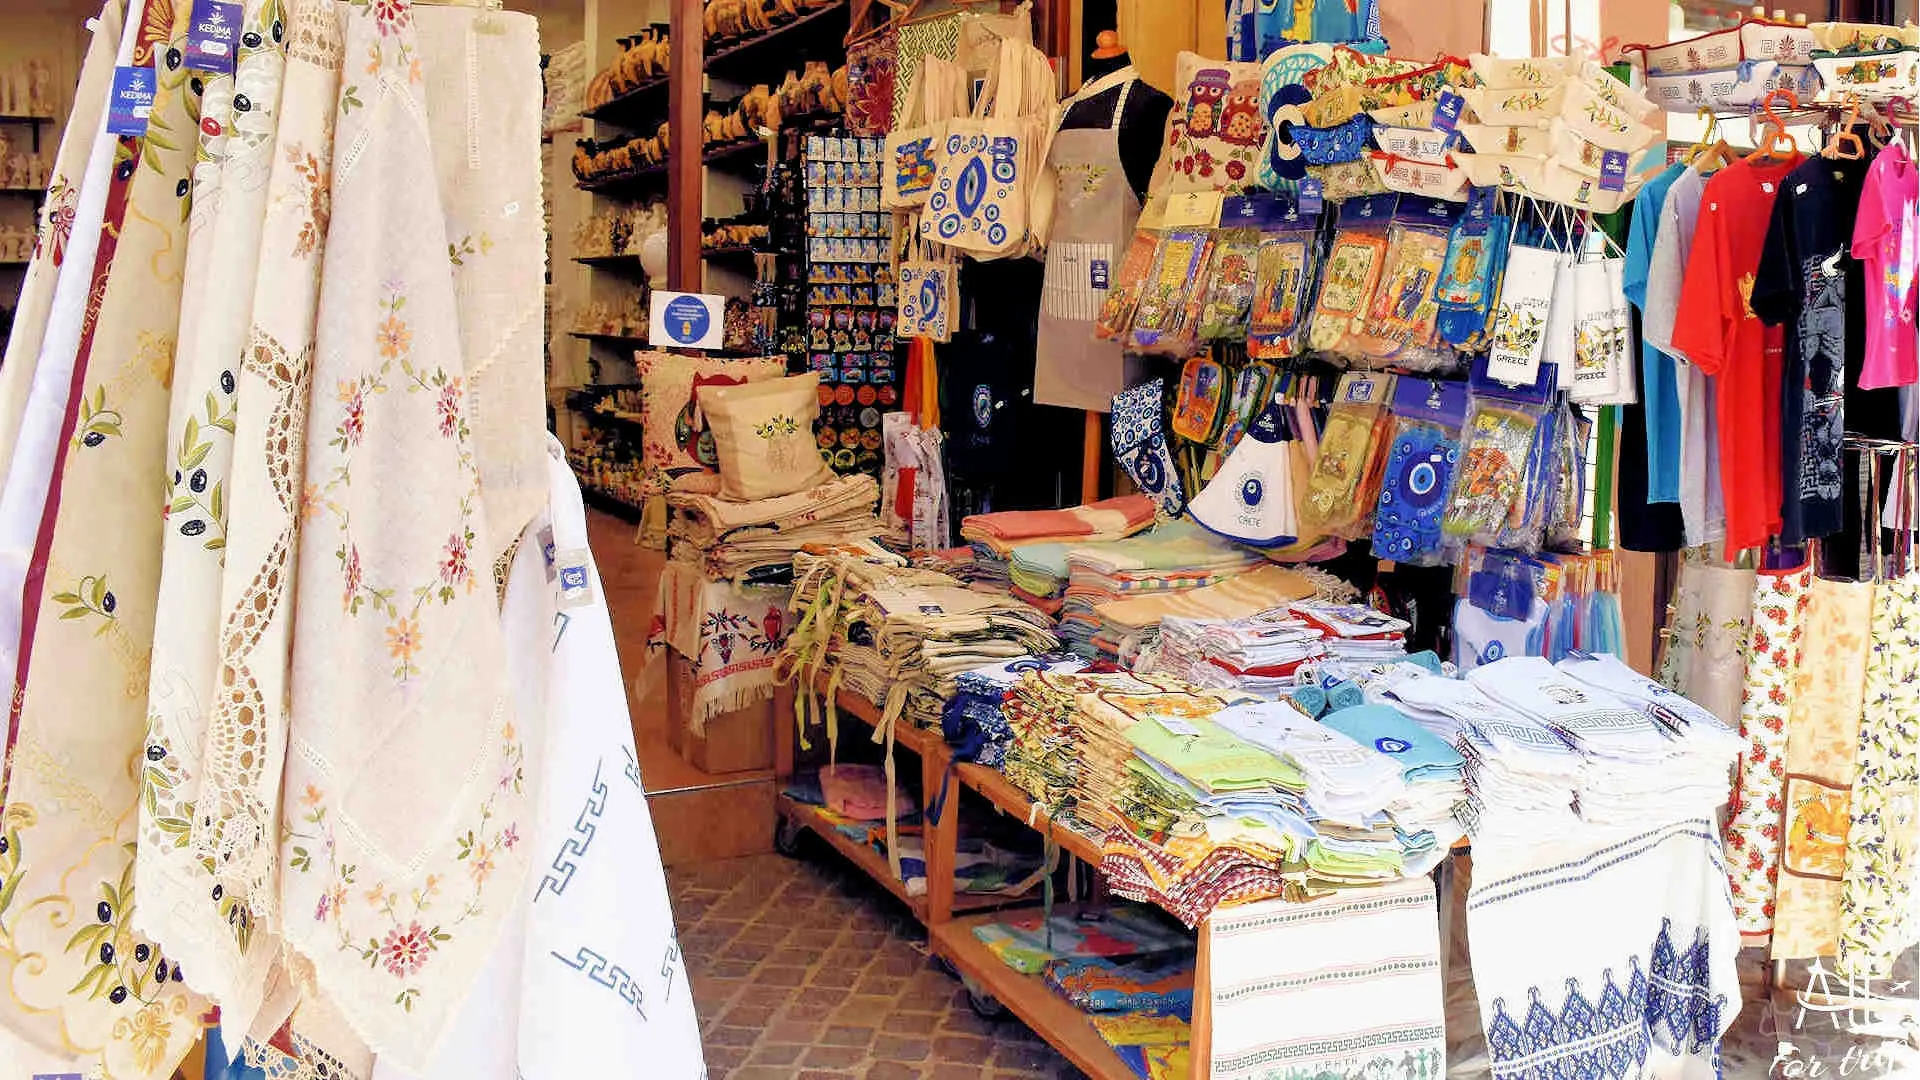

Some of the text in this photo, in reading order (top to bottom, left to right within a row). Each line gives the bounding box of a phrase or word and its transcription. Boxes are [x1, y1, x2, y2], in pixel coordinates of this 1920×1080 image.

[198, 23, 231, 36] KEDIMA
[120, 88, 152, 101] KEDIMA
[1496, 353, 1529, 366] GREECE
